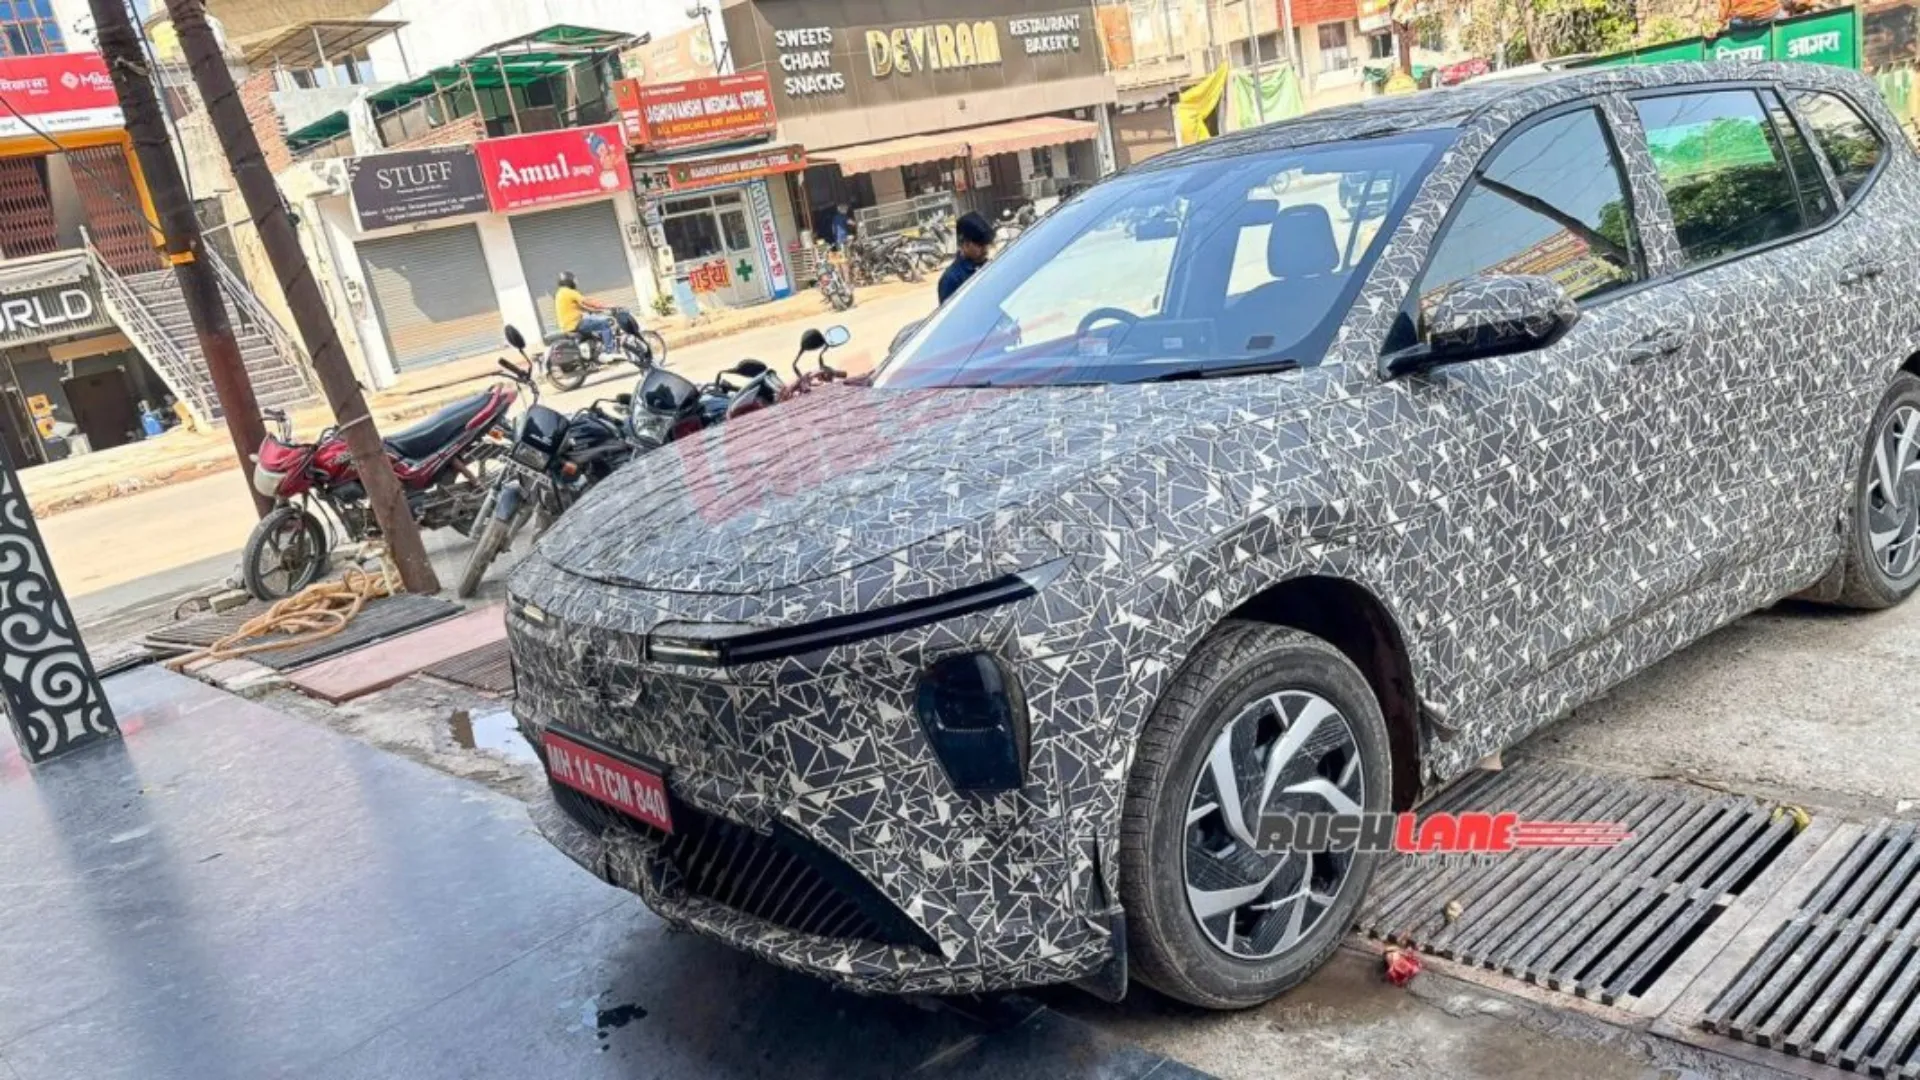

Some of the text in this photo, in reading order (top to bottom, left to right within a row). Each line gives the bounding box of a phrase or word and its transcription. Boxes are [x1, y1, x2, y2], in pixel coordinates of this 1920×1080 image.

[774, 27, 833, 48] SWEETS
[1009, 14, 1080, 36] RESTAURANT
[865, 21, 1002, 77] DEVIRAM
[1025, 35, 1069, 54] BAKERY
[1787, 30, 1840, 58] आगरा
[780, 50, 831, 71] CHAAT
[784, 72, 845, 96] SNACKS
[376, 161, 452, 190] STUFF
[498, 152, 570, 189] Amul
[0, 289, 92, 332] RLD
[546, 743, 667, 823] MH 14 TCM 840
